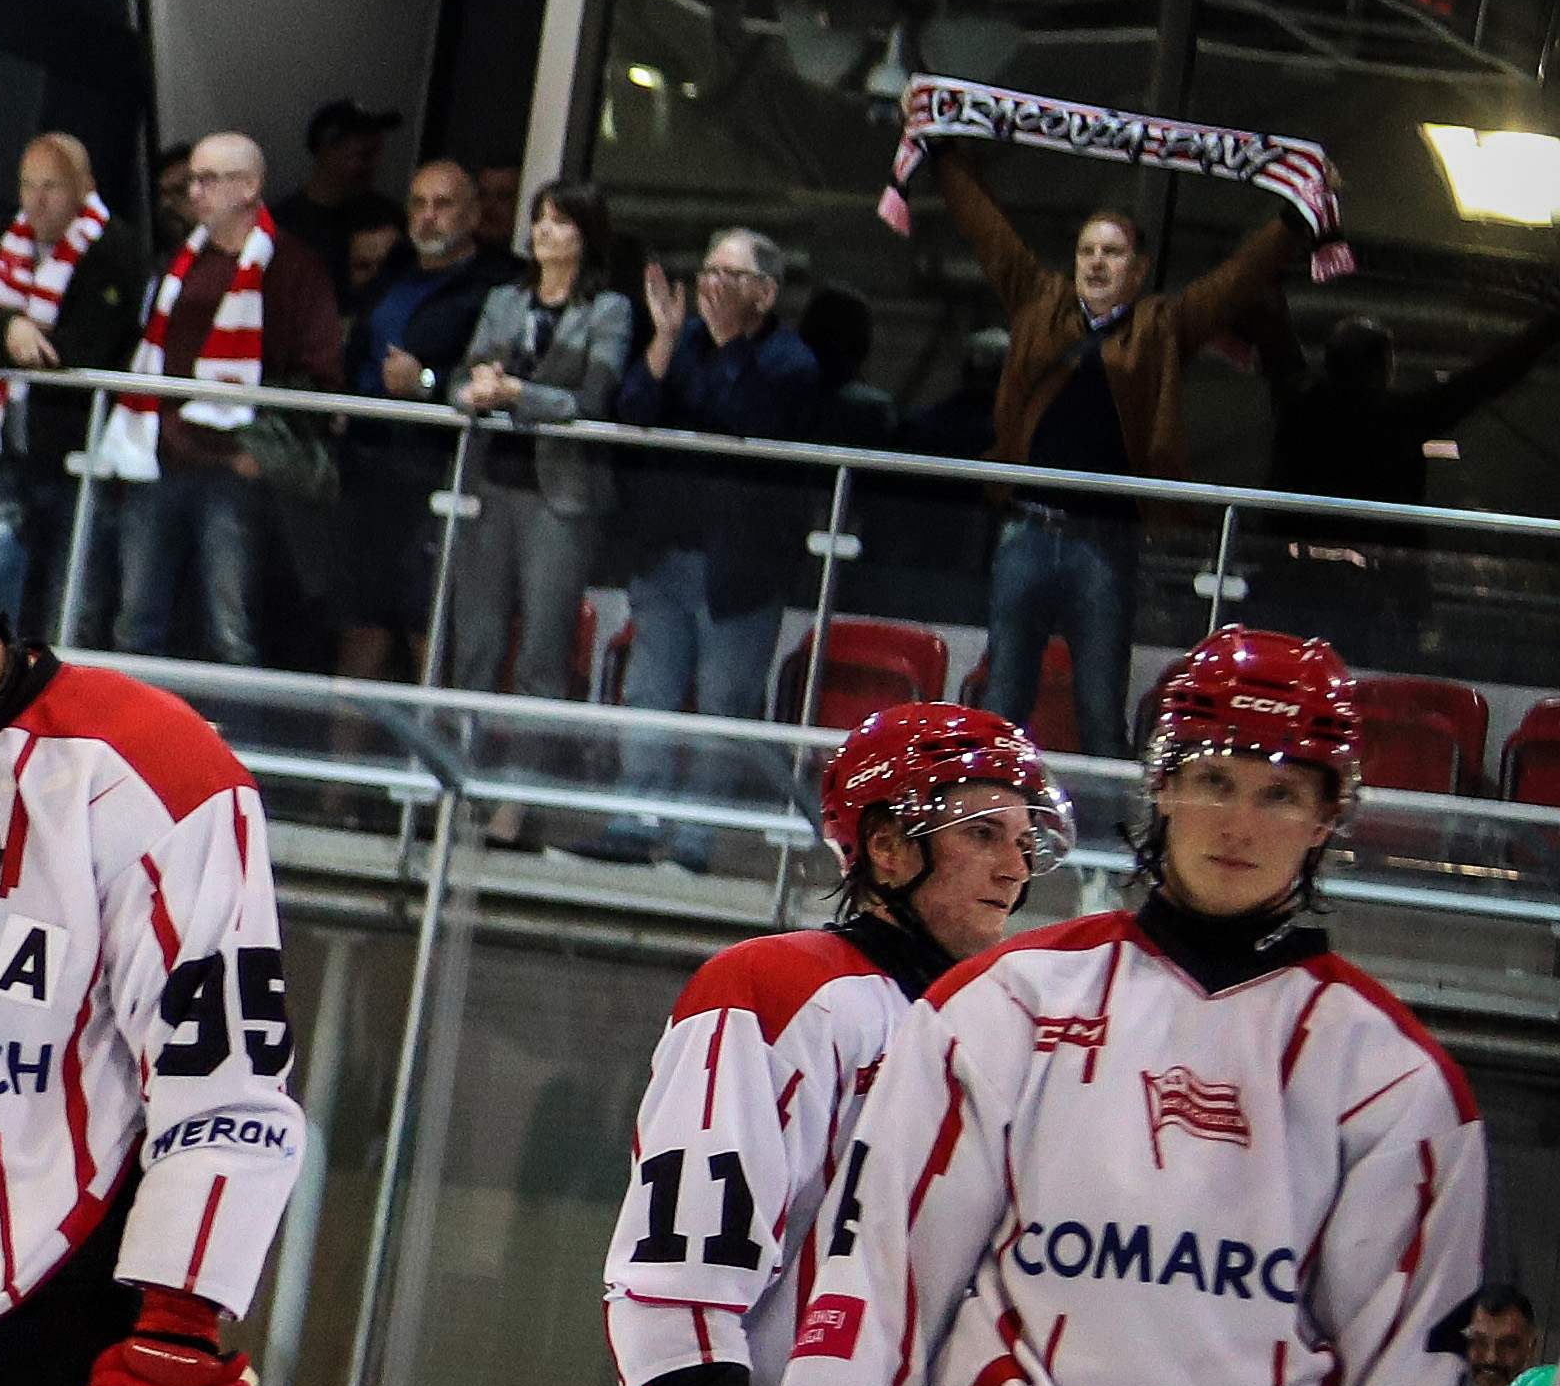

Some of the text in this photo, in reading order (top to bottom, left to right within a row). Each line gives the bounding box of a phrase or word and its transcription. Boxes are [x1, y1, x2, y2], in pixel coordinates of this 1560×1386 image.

[1231, 695, 1301, 717] CCM
[846, 762, 889, 790] CCM
[629, 1148, 763, 1271] 11
[1013, 1220, 1298, 1305] COMARC
